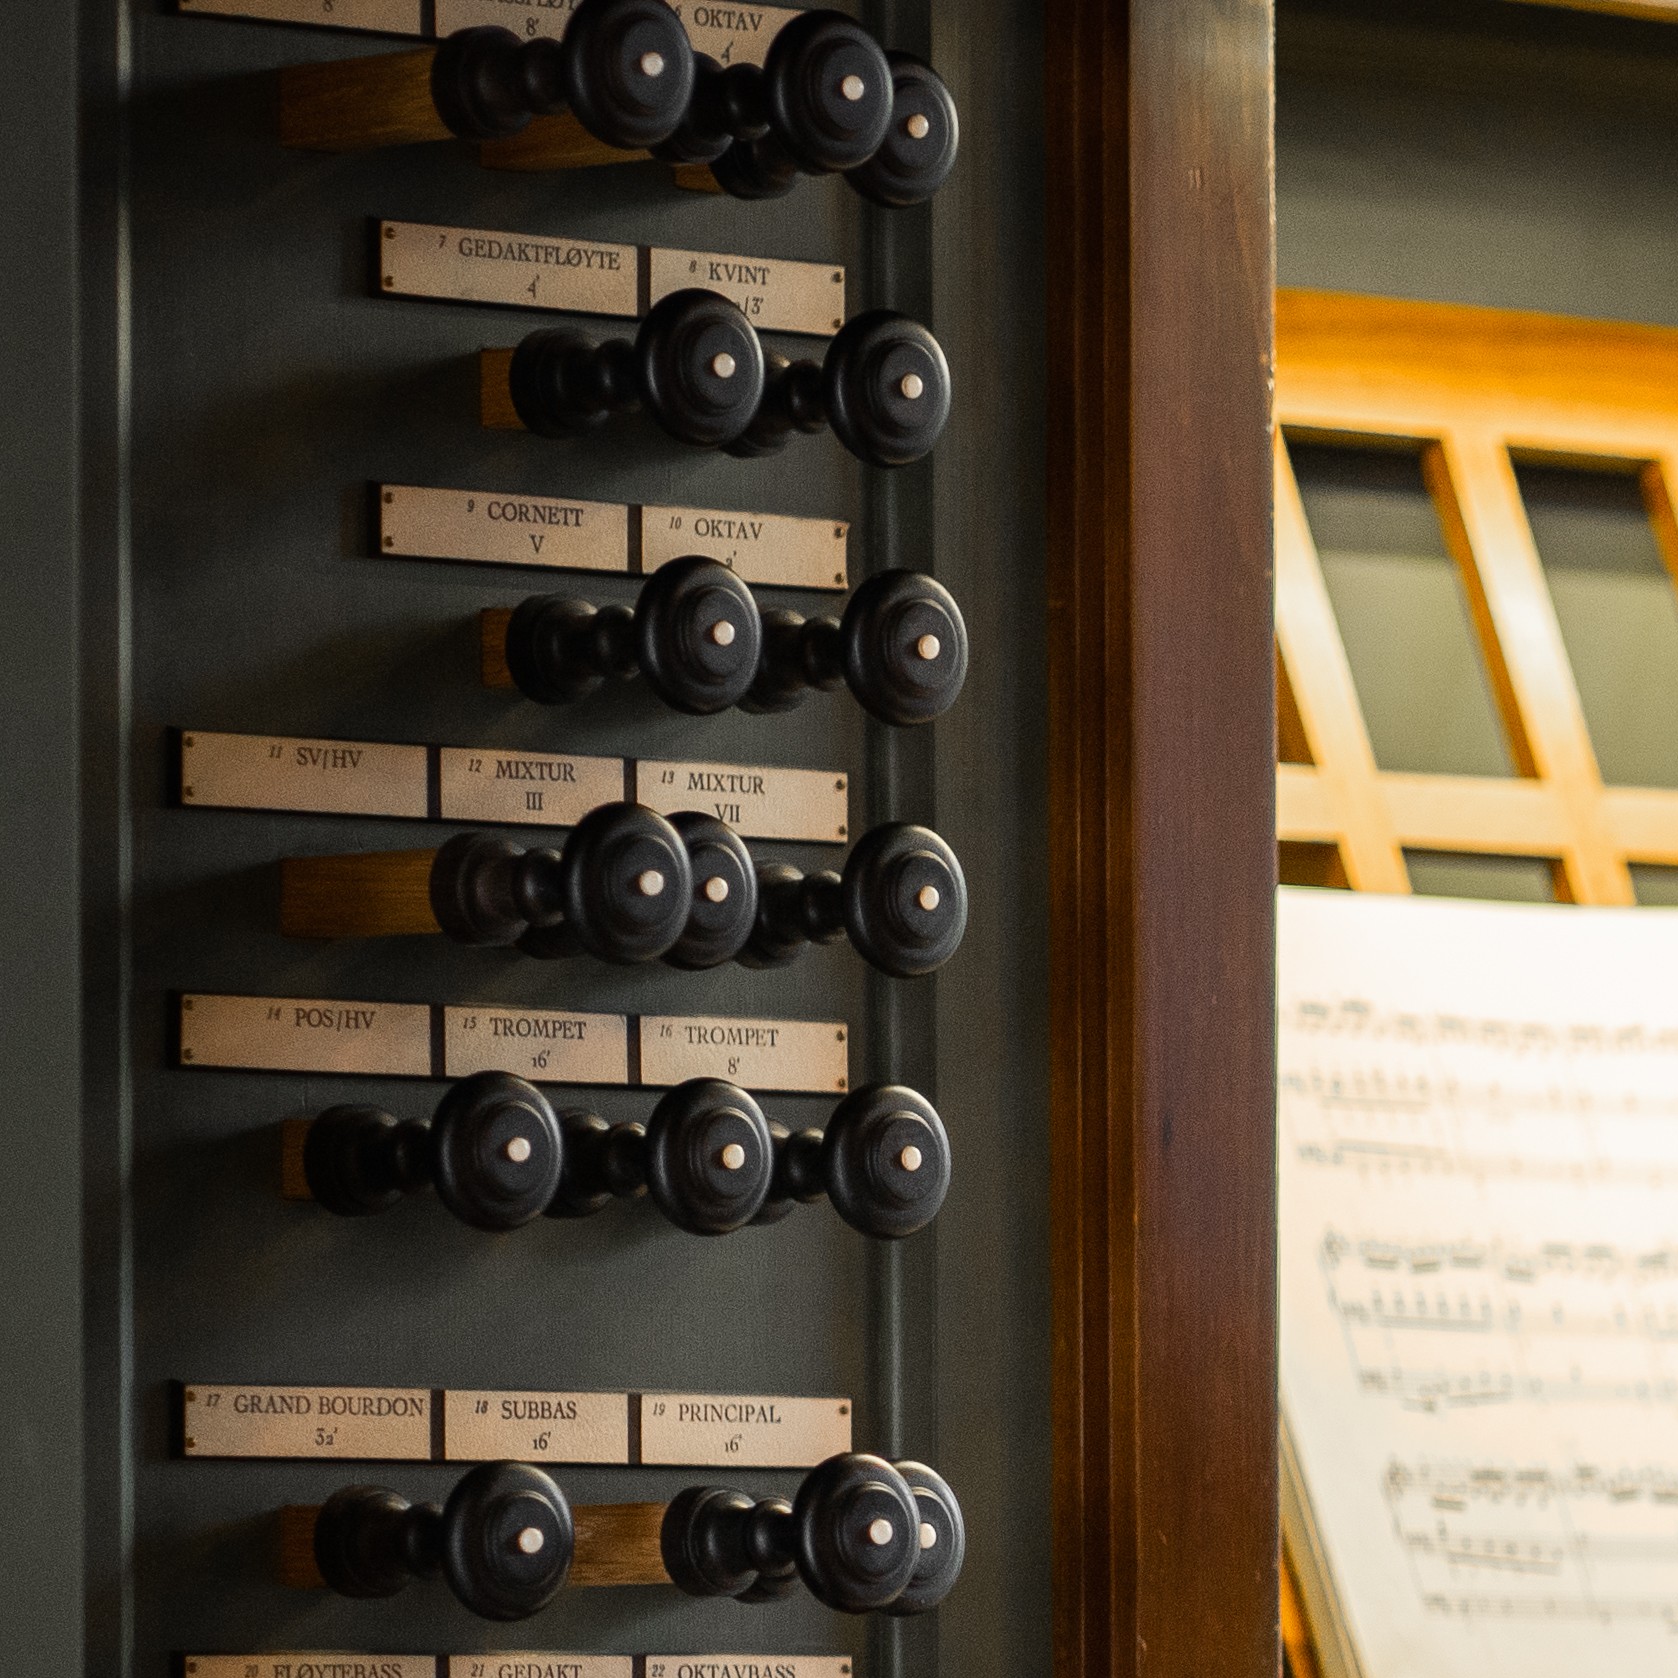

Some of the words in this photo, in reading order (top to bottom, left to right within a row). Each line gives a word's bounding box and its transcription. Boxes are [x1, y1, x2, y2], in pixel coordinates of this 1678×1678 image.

[694, 6, 763, 31] OKTAV
[438, 235, 447, 249] 7
[459, 237, 621, 270] GEDAKTFLØYTE
[708, 261, 770, 286] KVINT
[467, 499, 475, 513] 9
[487, 501, 584, 527] CORNETT
[669, 516, 682, 530] 10
[694, 518, 763, 541] OKTAV
[529, 534, 544, 554] V
[296, 747, 363, 769] SV/HV
[468, 758, 482, 773] 12
[495, 760, 576, 783] MIXTUR
[661, 770, 675, 784] 13
[687, 772, 765, 795] MIXTUR
[525, 791, 543, 811] III
[714, 803, 740, 823] VII
[295, 1008, 376, 1031] POS/HV
[463, 1016, 477, 1029] 15
[489, 1016, 587, 1040] TROMPET
[659, 1024, 672, 1038] 16
[684, 1024, 779, 1048] TROMPET
[206, 1393, 221, 1407] 17
[234, 1393, 311, 1415] GRAND
[319, 1395, 425, 1417] BOURDON
[474, 1400, 488, 1414] 18
[501, 1400, 577, 1421] SUBBAS
[653, 1402, 666, 1416] 19
[678, 1403, 782, 1424] PRINCIPAL
[471, 1663, 485, 1678] 21
[651, 1663, 666, 1678] 22
